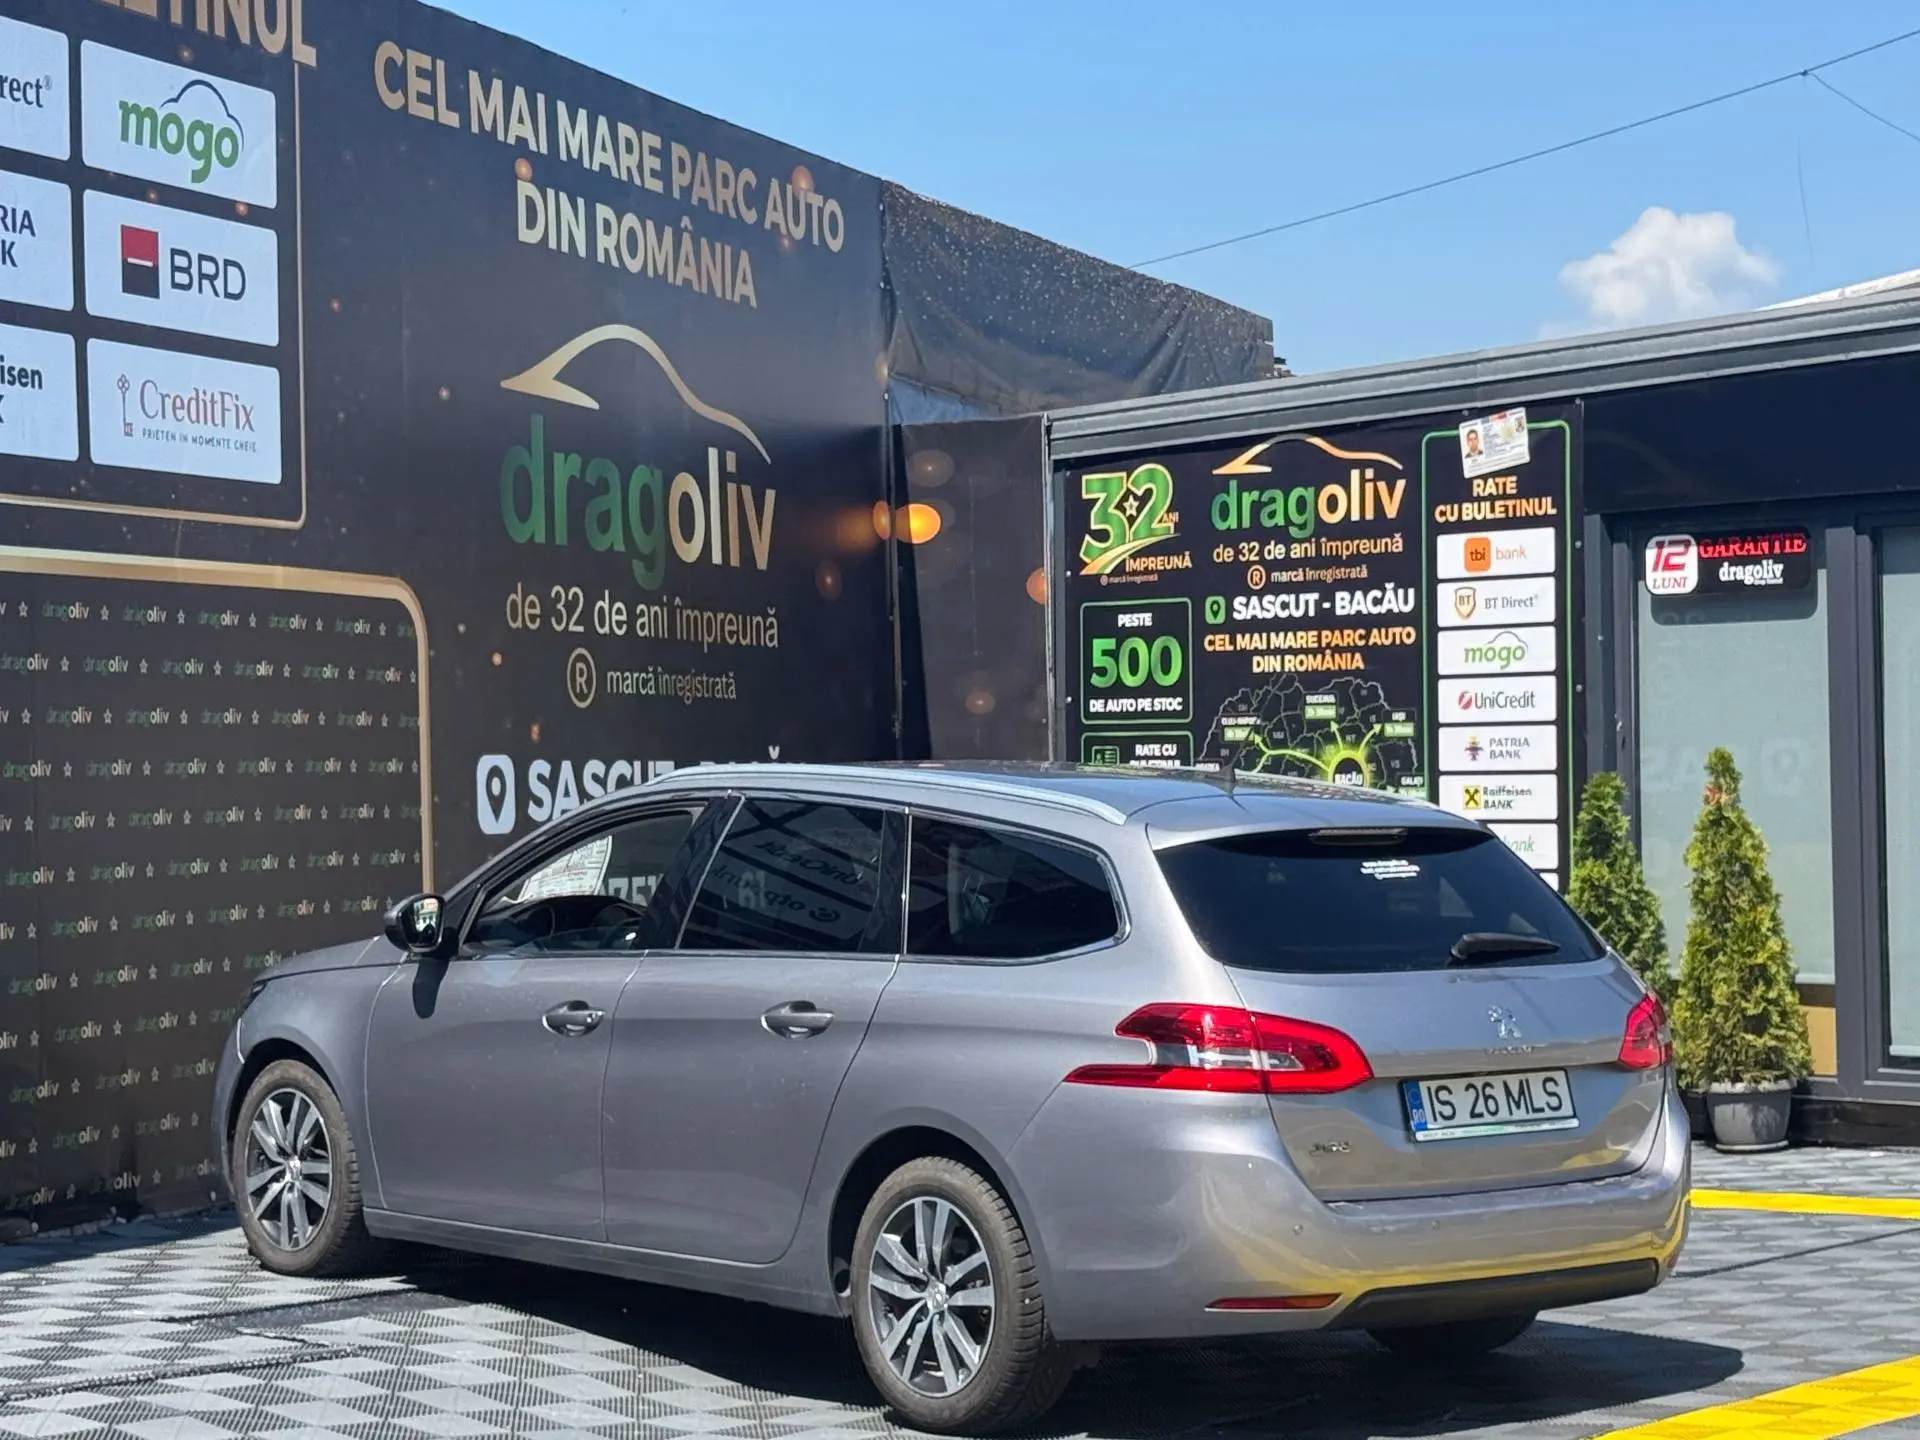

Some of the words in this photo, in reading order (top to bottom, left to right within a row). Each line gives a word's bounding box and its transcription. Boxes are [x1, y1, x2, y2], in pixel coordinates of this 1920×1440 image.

[119, 100, 239, 184] mogo
[374, 41, 460, 129] CEL
[468, 69, 547, 154] MAI
[557, 99, 663, 193] MARE
[671, 141, 758, 224] PARC
[765, 177, 844, 253] AUTO
[517, 179, 587, 258] DIN
[596, 202, 758, 309] ROMÂNIA
[169, 247, 246, 301] BRD
[140, 379, 255, 432] CreditFix
[1473, 476, 1518, 497] RATE
[502, 414, 777, 591] dragoliv
[1211, 467, 1407, 538] dragoliv
[1435, 505, 1458, 522] CU
[1462, 497, 1557, 520] BULETINUL
[1213, 544, 1234, 563] de
[1239, 542, 1259, 561] 32
[1264, 539, 1286, 560] de
[1290, 538, 1316, 558] ani
[1320, 533, 1403, 560] împreună
[1470, 548, 1486, 562] tbi
[1496, 545, 1527, 560] bank
[1652, 539, 1692, 573] 12
[1271, 567, 1304, 583] marcă
[1305, 565, 1368, 583] înregistrată
[1653, 576, 1688, 590] LUNI
[1719, 559, 1784, 586] dragoliv
[1232, 593, 1319, 620] SASCUT
[1335, 582, 1416, 616] BACĂU
[1485, 597, 1498, 609] BT
[506, 582, 541, 631] de
[551, 585, 585, 633] 32
[594, 590, 628, 637] de
[636, 595, 668, 640] ani
[674, 596, 779, 653] împreună
[1118, 612, 1153, 628] PESTE
[1204, 632, 1234, 651] CEL
[1237, 631, 1267, 650] MAI
[1270, 629, 1319, 650] MARE
[1321, 629, 1366, 648] PARC
[1369, 626, 1416, 646] AUTO
[1090, 635, 1183, 689] 500
[1253, 655, 1285, 673] DIN
[1287, 650, 1364, 672] ROMÂNIA
[1464, 644, 1526, 670] mogo
[606, 666, 656, 696] marcă
[658, 666, 737, 705] înregistrată
[1089, 700, 1107, 713] DE
[1107, 699, 1137, 712] AUTO
[1138, 699, 1153, 711] PE
[1154, 697, 1183, 711] STOC
[1475, 691, 1535, 710] UniCredit
[1135, 743, 1161, 756] RATE
[1162, 743, 1177, 756] CU
[1489, 737, 1530, 748] PATRIA
[1489, 748, 1521, 760] BANK
[1483, 786, 1532, 796] Raiffeisen
[1483, 800, 1513, 809] BANK
[1427, 1085, 1456, 1122] IS
[1464, 1081, 1500, 1120] 26
[1503, 1076, 1564, 1118] MLS
